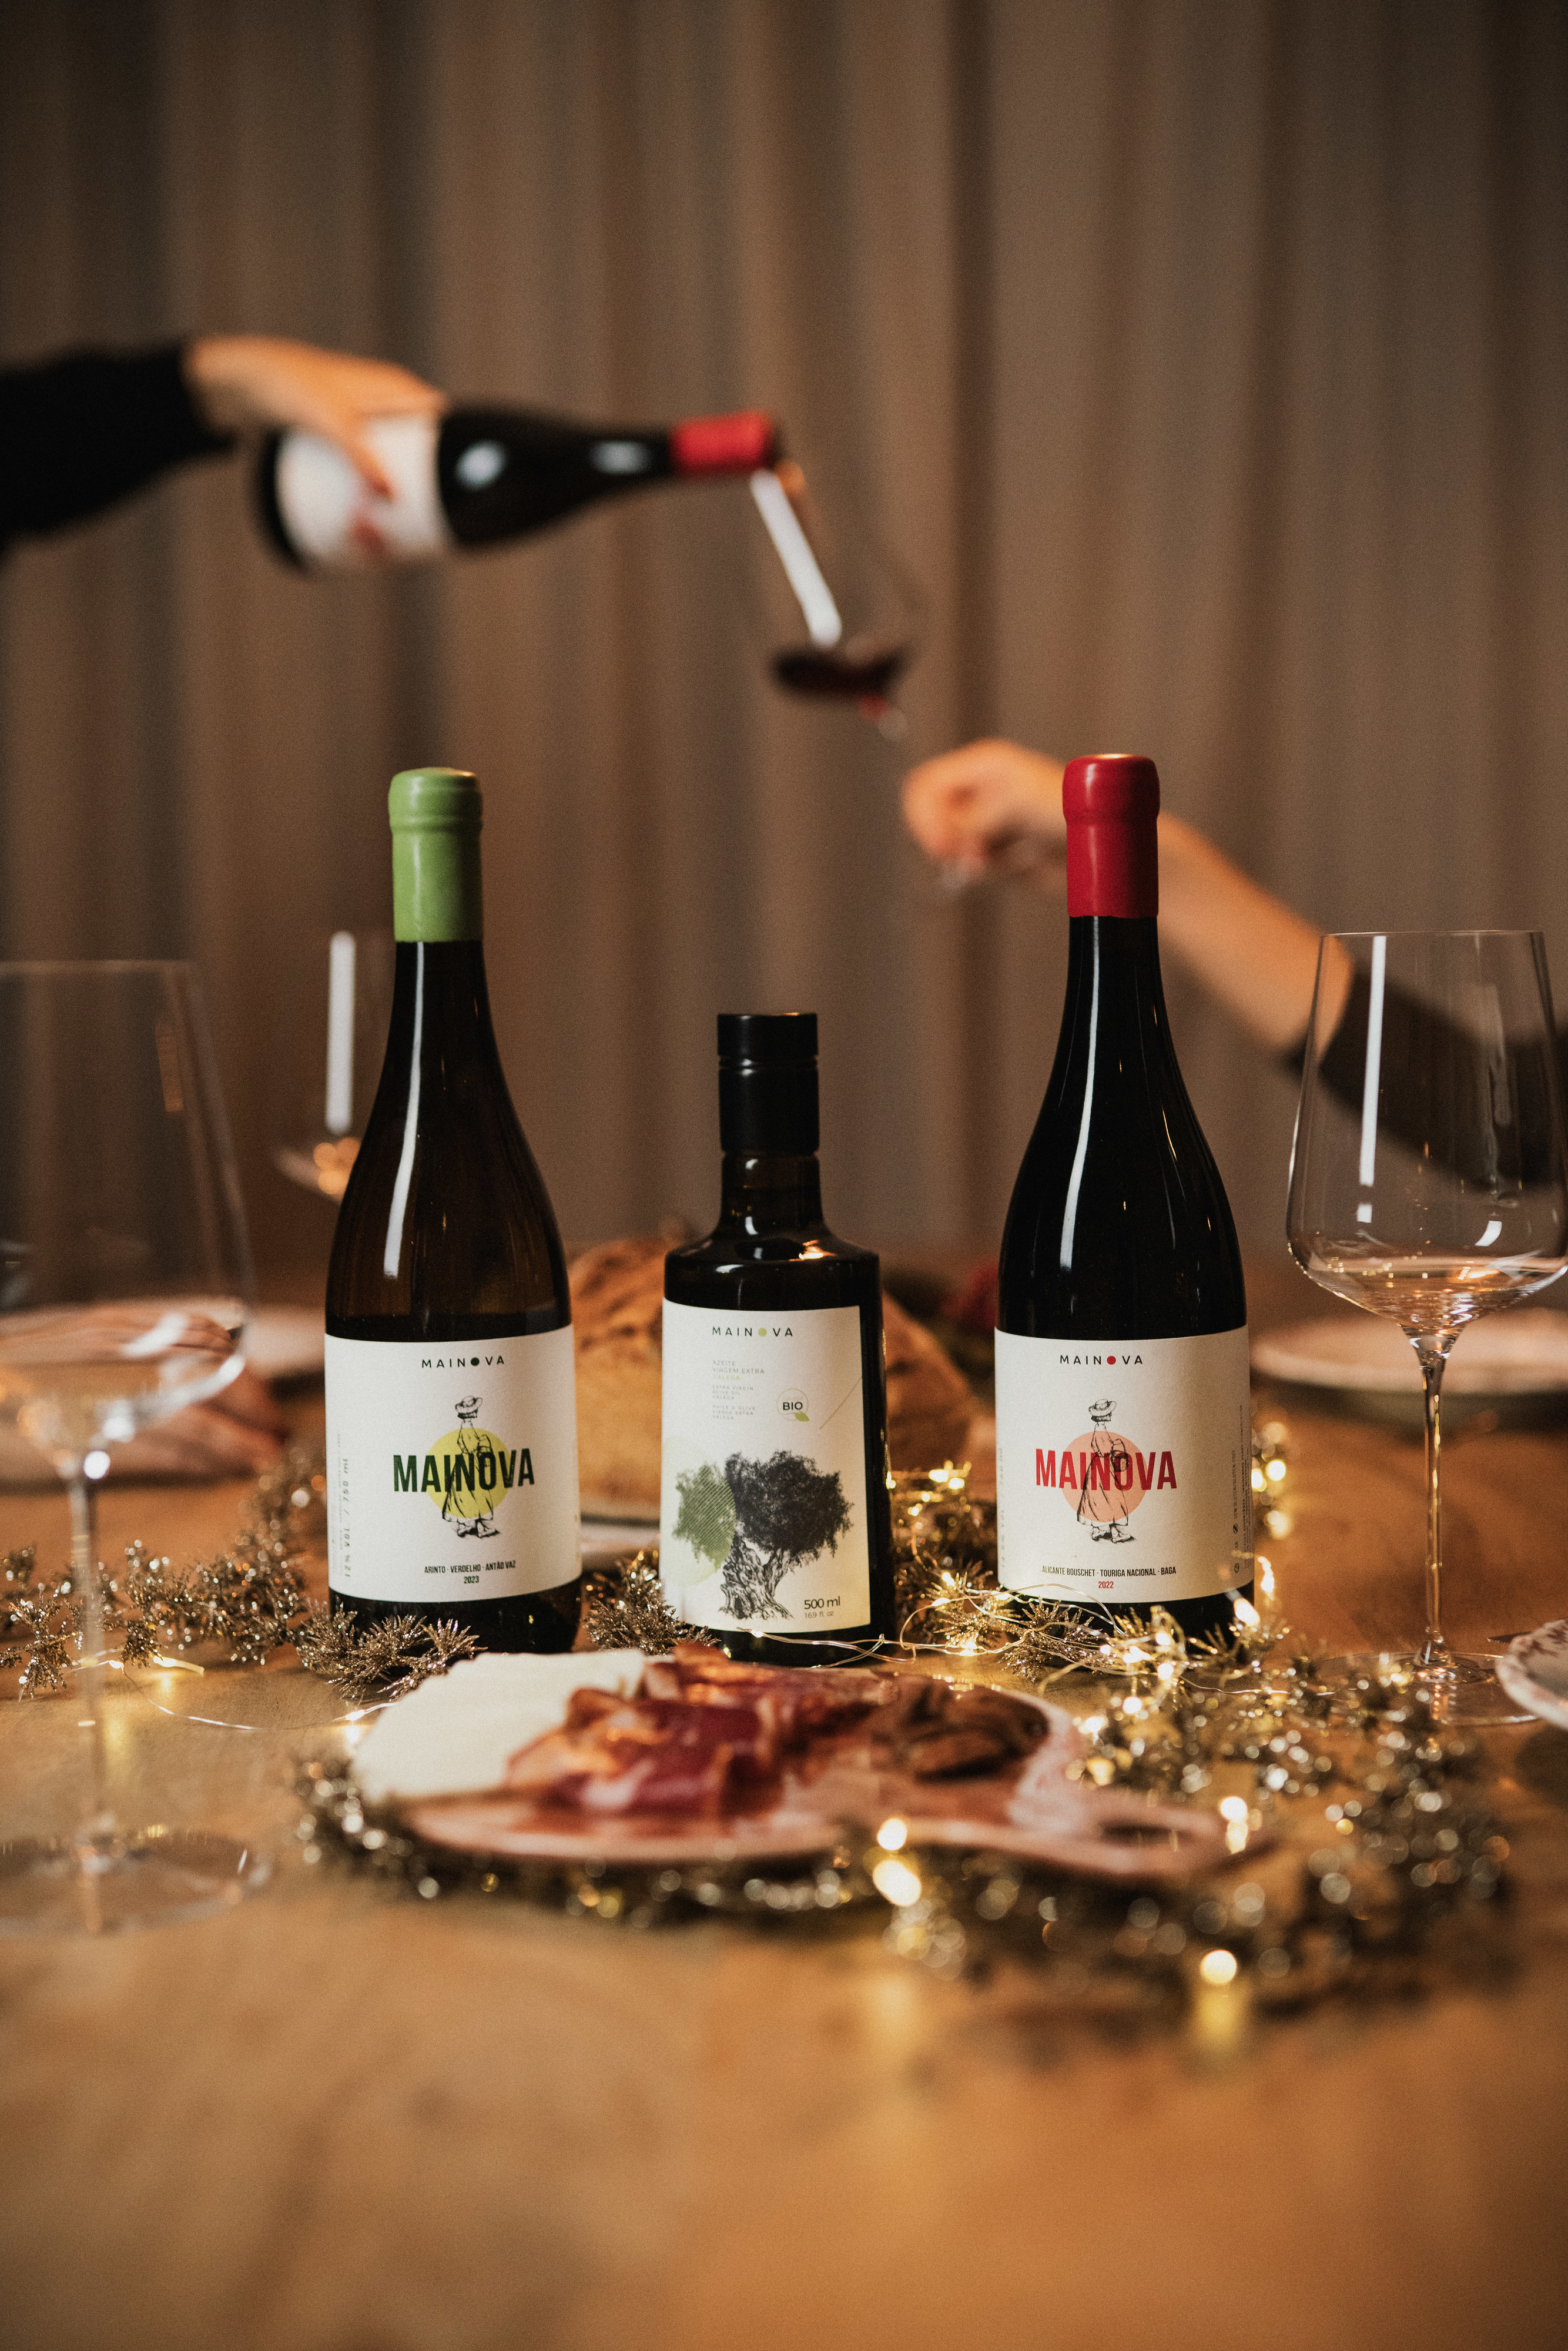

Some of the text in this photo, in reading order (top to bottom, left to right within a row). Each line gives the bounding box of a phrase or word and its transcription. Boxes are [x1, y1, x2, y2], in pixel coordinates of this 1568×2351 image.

[783, 1401, 803, 1411] BIO
[393, 1448, 535, 1493] MAINOVA
[1036, 1448, 1177, 1492] MAINOVA
[450, 1564, 481, 1573] VERDELHO
[485, 1560, 504, 1570] ANTÃO
[505, 1560, 516, 1569] VAZ
[1042, 1566, 1065, 1575] ALICANTE
[1067, 1568, 1095, 1577] BOUSCHET
[1127, 1568, 1156, 1577] NACIONAL
[1161, 1566, 1177, 1575] BAGA
[464, 1575, 479, 1584] 2023
[804, 1596, 840, 1609] 500 ml
